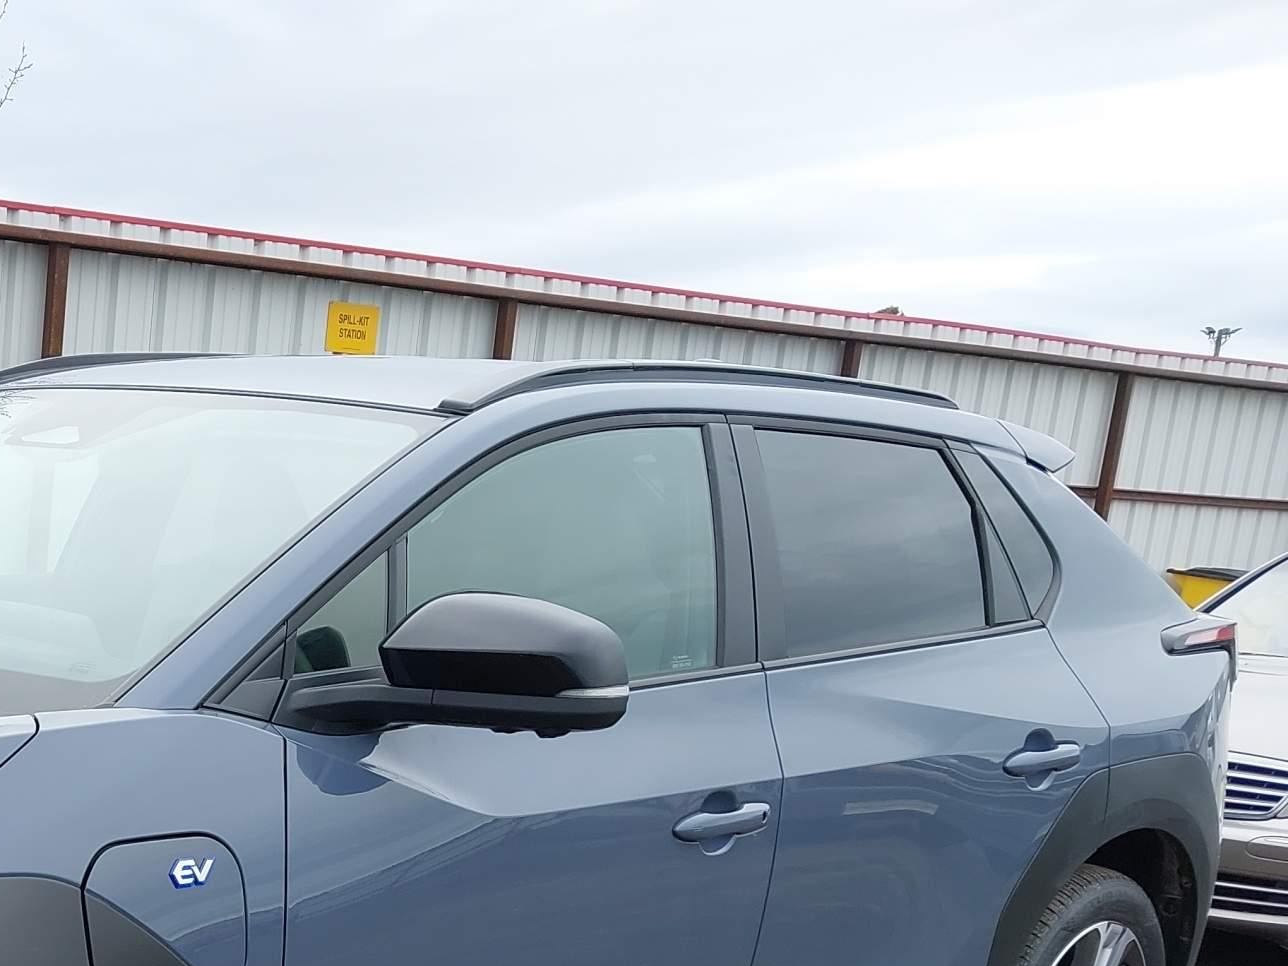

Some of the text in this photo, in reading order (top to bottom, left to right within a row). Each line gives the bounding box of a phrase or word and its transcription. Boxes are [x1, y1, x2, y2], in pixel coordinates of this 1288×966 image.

[338, 313, 370, 326] SPILL-KIT
[338, 328, 367, 340] STATION
[169, 857, 215, 888] EV
